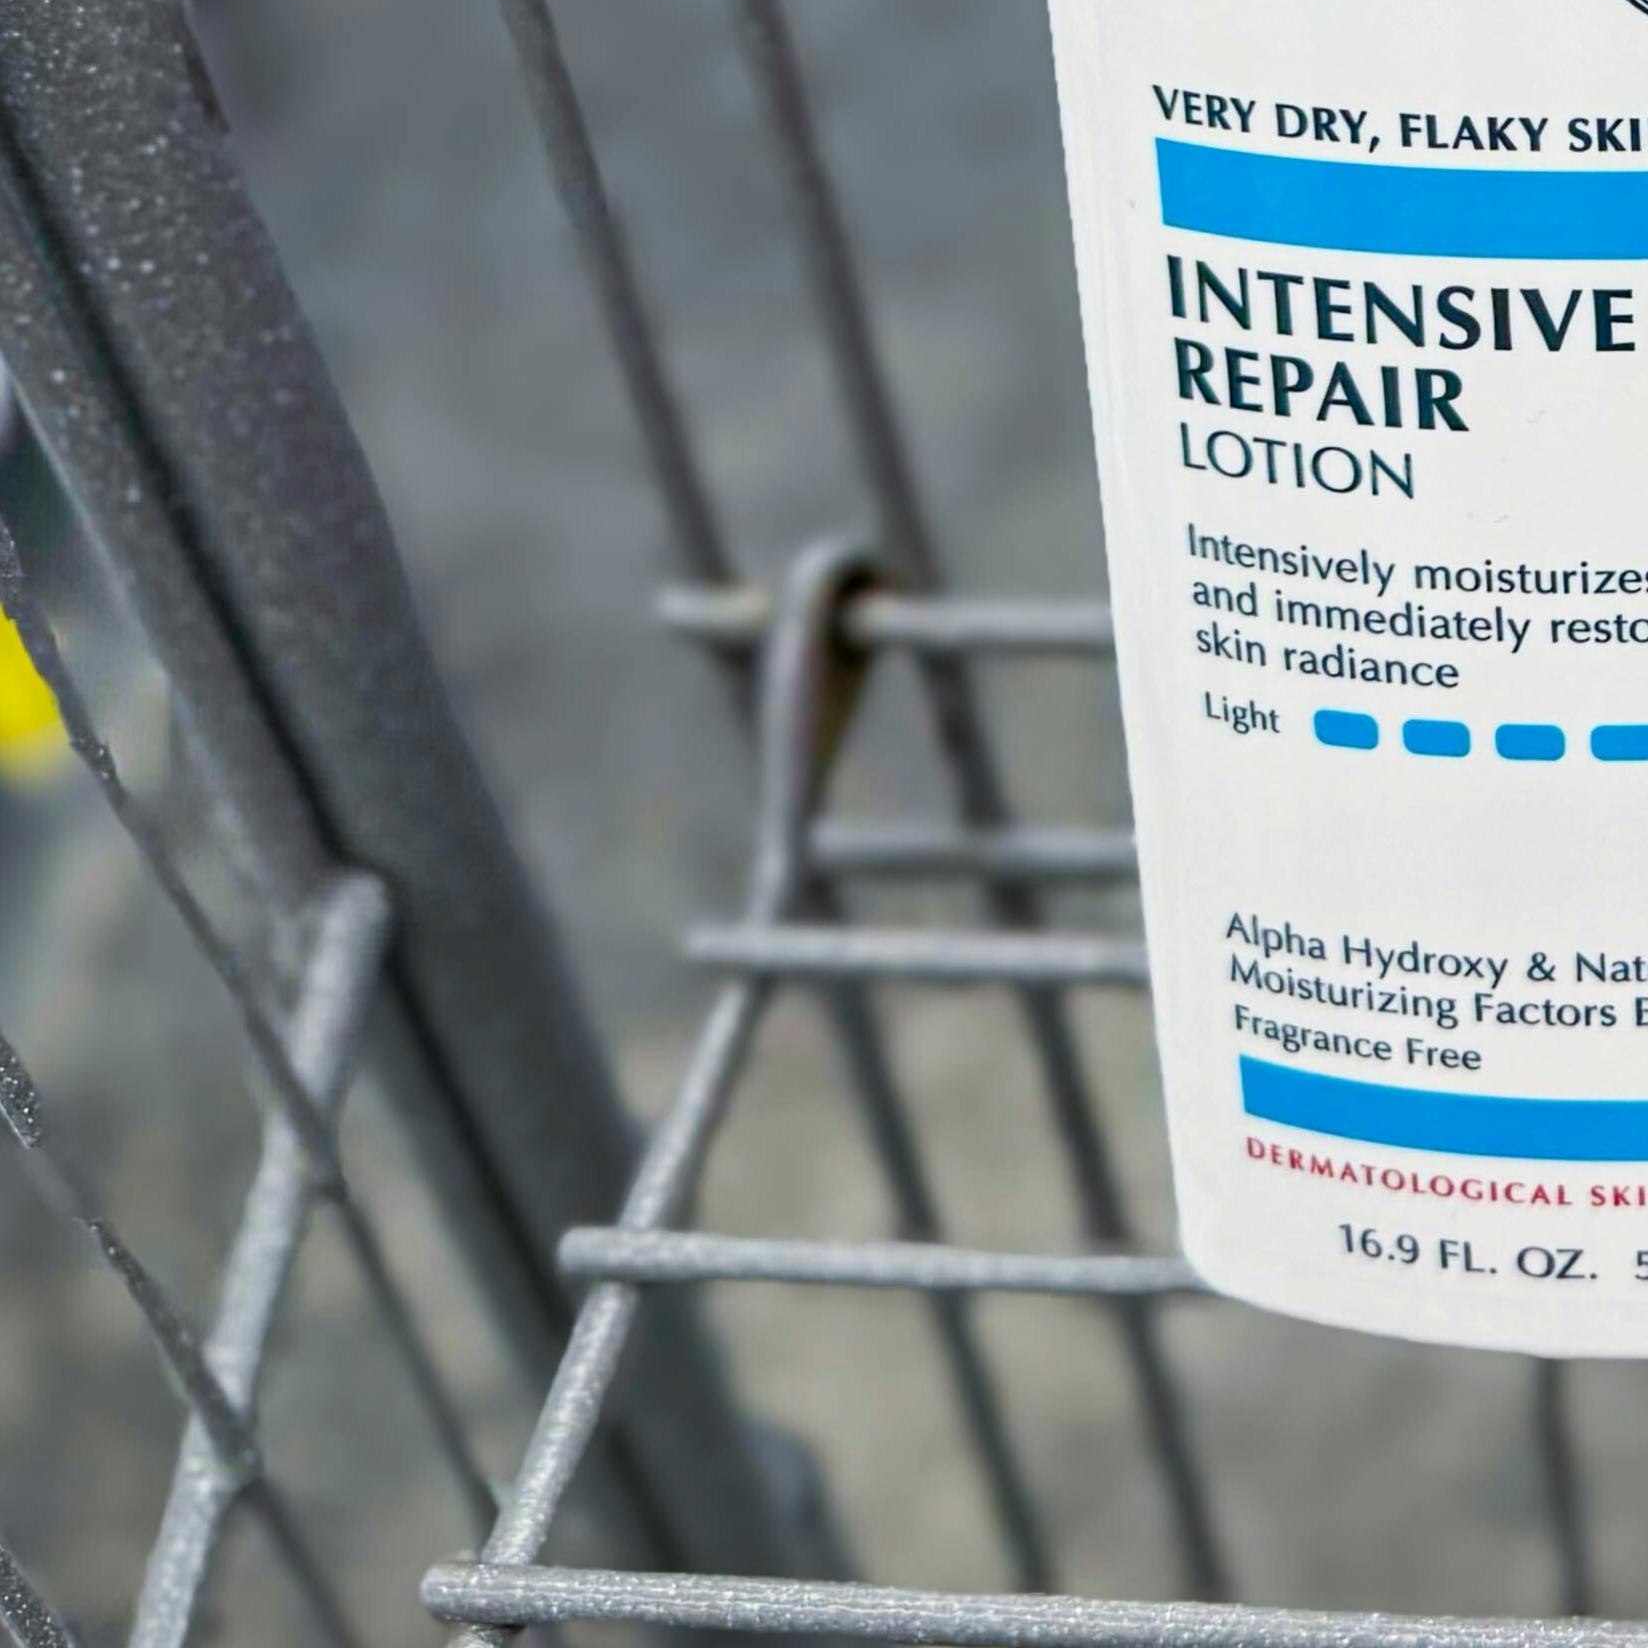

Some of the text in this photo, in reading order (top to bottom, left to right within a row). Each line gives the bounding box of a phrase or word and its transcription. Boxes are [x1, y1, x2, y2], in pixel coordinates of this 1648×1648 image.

[1153, 84, 1256, 134] VERY
[1275, 102, 1380, 154] DRY,
[1399, 112, 1548, 153] FLAKY
[1165, 254, 1637, 353] INTENSIVE
[1174, 337, 1471, 433] REPAIR
[1179, 422, 1415, 501] LOTION
[1187, 522, 1396, 598] Intensively
[1192, 577, 1259, 619] and
[1274, 587, 1530, 654] immediately
[1197, 622, 1460, 690] skin radiance
[1204, 690, 1282, 736] Light
[1226, 912, 1327, 963] Alpha
[1343, 935, 1508, 989] Hydroxy
[1526, 954, 1557, 984] &
[1229, 955, 1459, 1030] Moisturizing
[1474, 993, 1618, 1029] Factors
[1234, 1004, 1482, 1073] Fragrance Free
[1245, 1137, 1573, 1208] DERMATOLOGICAL
[1338, 1223, 1421, 1266] 16.9
[1439, 1238, 1498, 1276] FL.
[1516, 1246, 1600, 1282] OZ.
